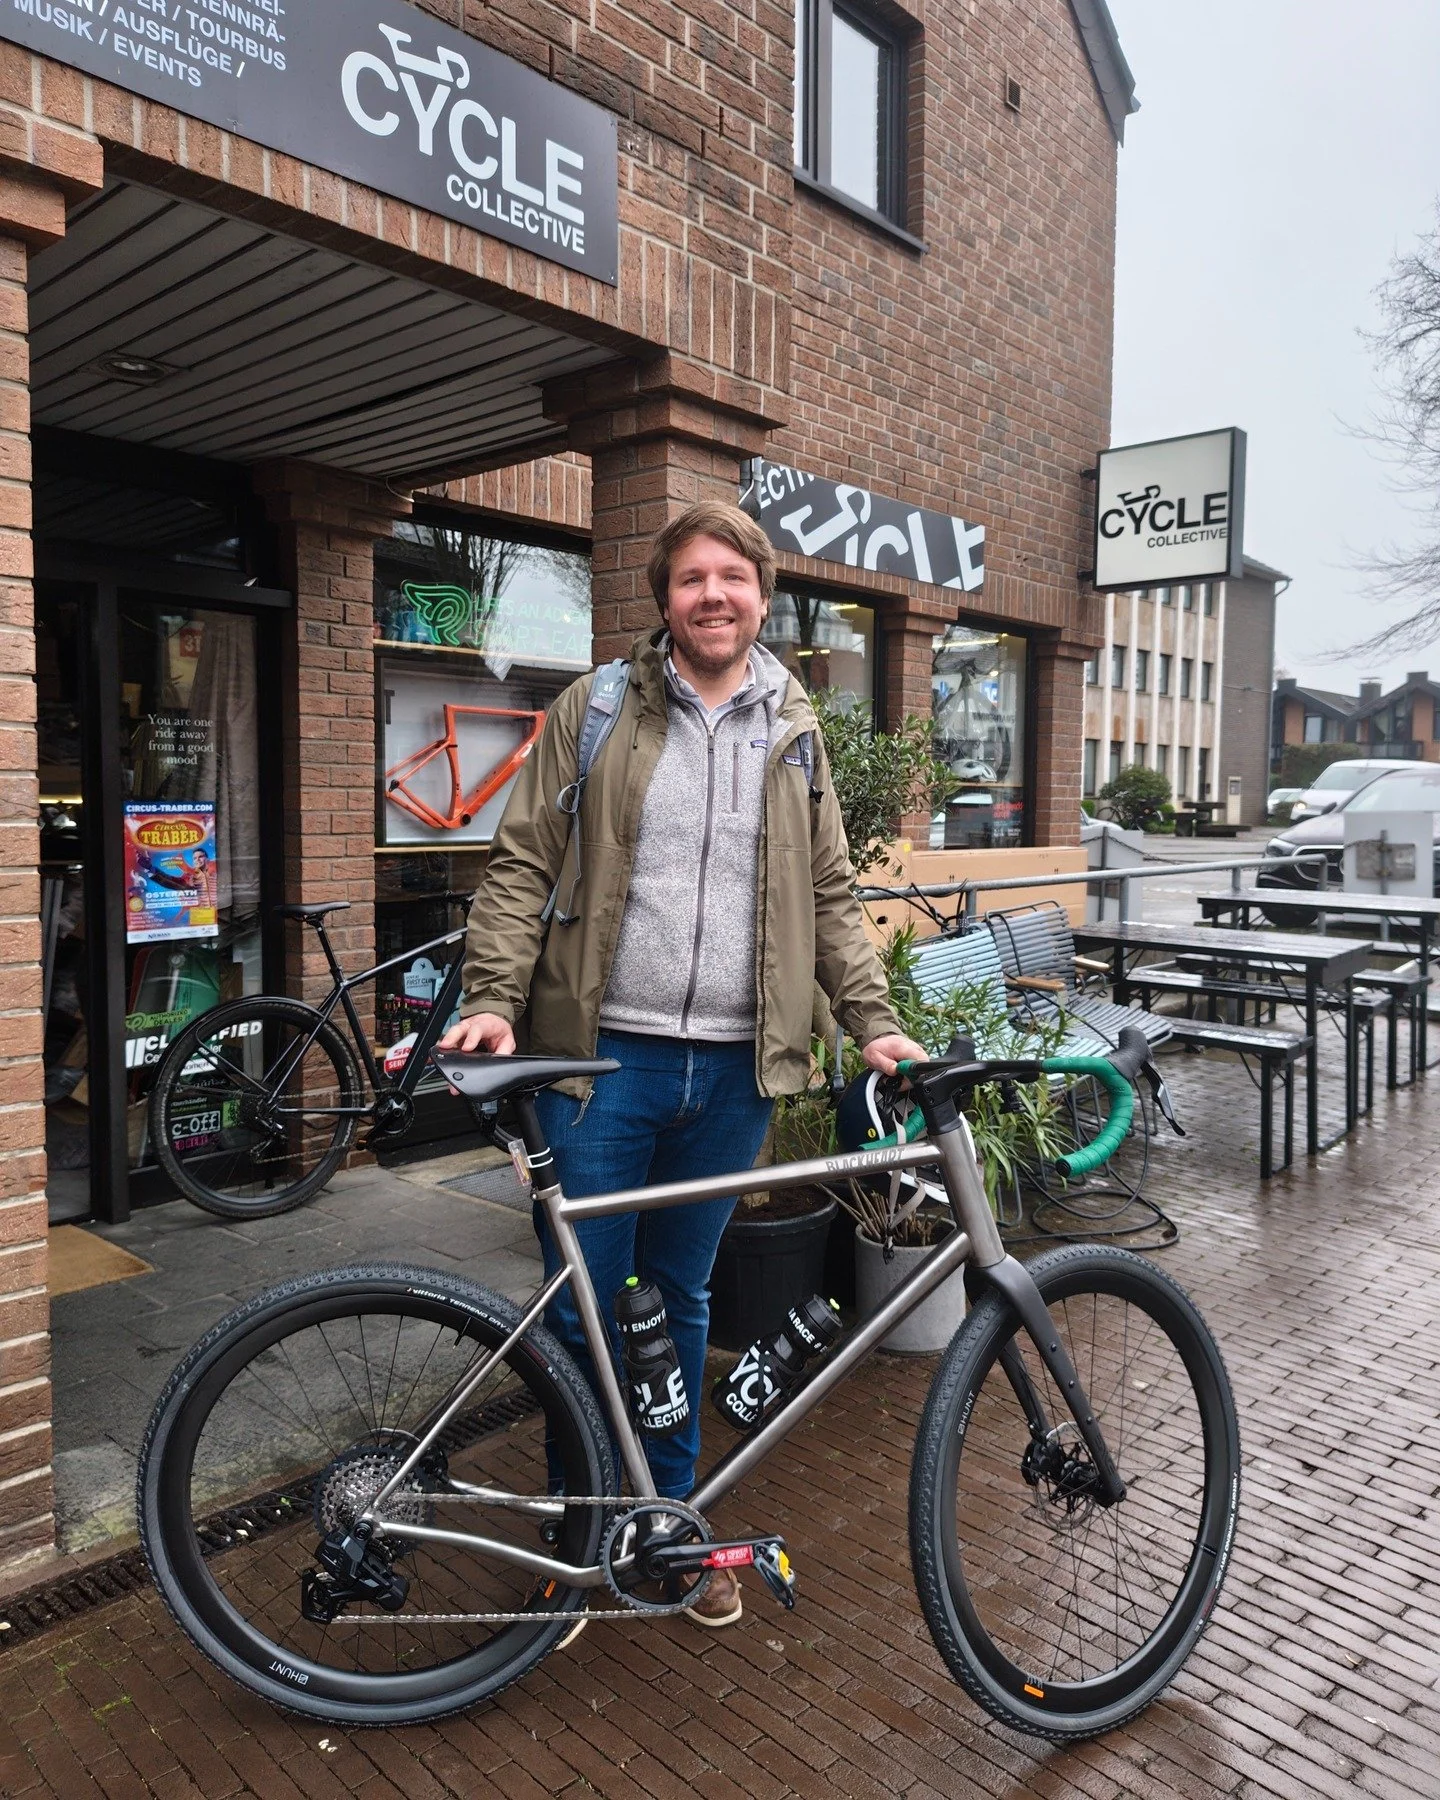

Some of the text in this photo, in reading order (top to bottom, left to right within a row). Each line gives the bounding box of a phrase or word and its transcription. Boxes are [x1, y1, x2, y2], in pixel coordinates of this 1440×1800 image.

[14, 0, 93, 42] MUSIK
[113, 33, 202, 88] EVENTS
[113, 6, 232, 74] AUSFLÜGE
[186, 9, 286, 71] TOURBUS
[341, 50, 584, 225] CYCLE
[446, 174, 585, 255] COLLECTIVE
[1100, 491, 1228, 539] CYCLE
[1147, 528, 1229, 548] COLLECTIVE
[148, 713, 213, 727] You are one
[155, 727, 207, 743] ride away
[149, 740, 175, 751] from
[187, 742, 214, 755] good
[166, 754, 198, 765] mood
[126, 804, 213, 813] CIRCUS-TRABER.COM
[141, 830, 199, 846] TRABER
[154, 823, 188, 831] CIRCUS
[826, 1148, 906, 1171] BLACKHEART
[413, 1289, 446, 1301] vittoria
[450, 1298, 488, 1318] TERRENO
[631, 1313, 661, 1333] ENJOY
[792, 1316, 816, 1344] RACE
[961, 1390, 975, 1424] HUNT
[268, 1660, 300, 1682] HUNT
